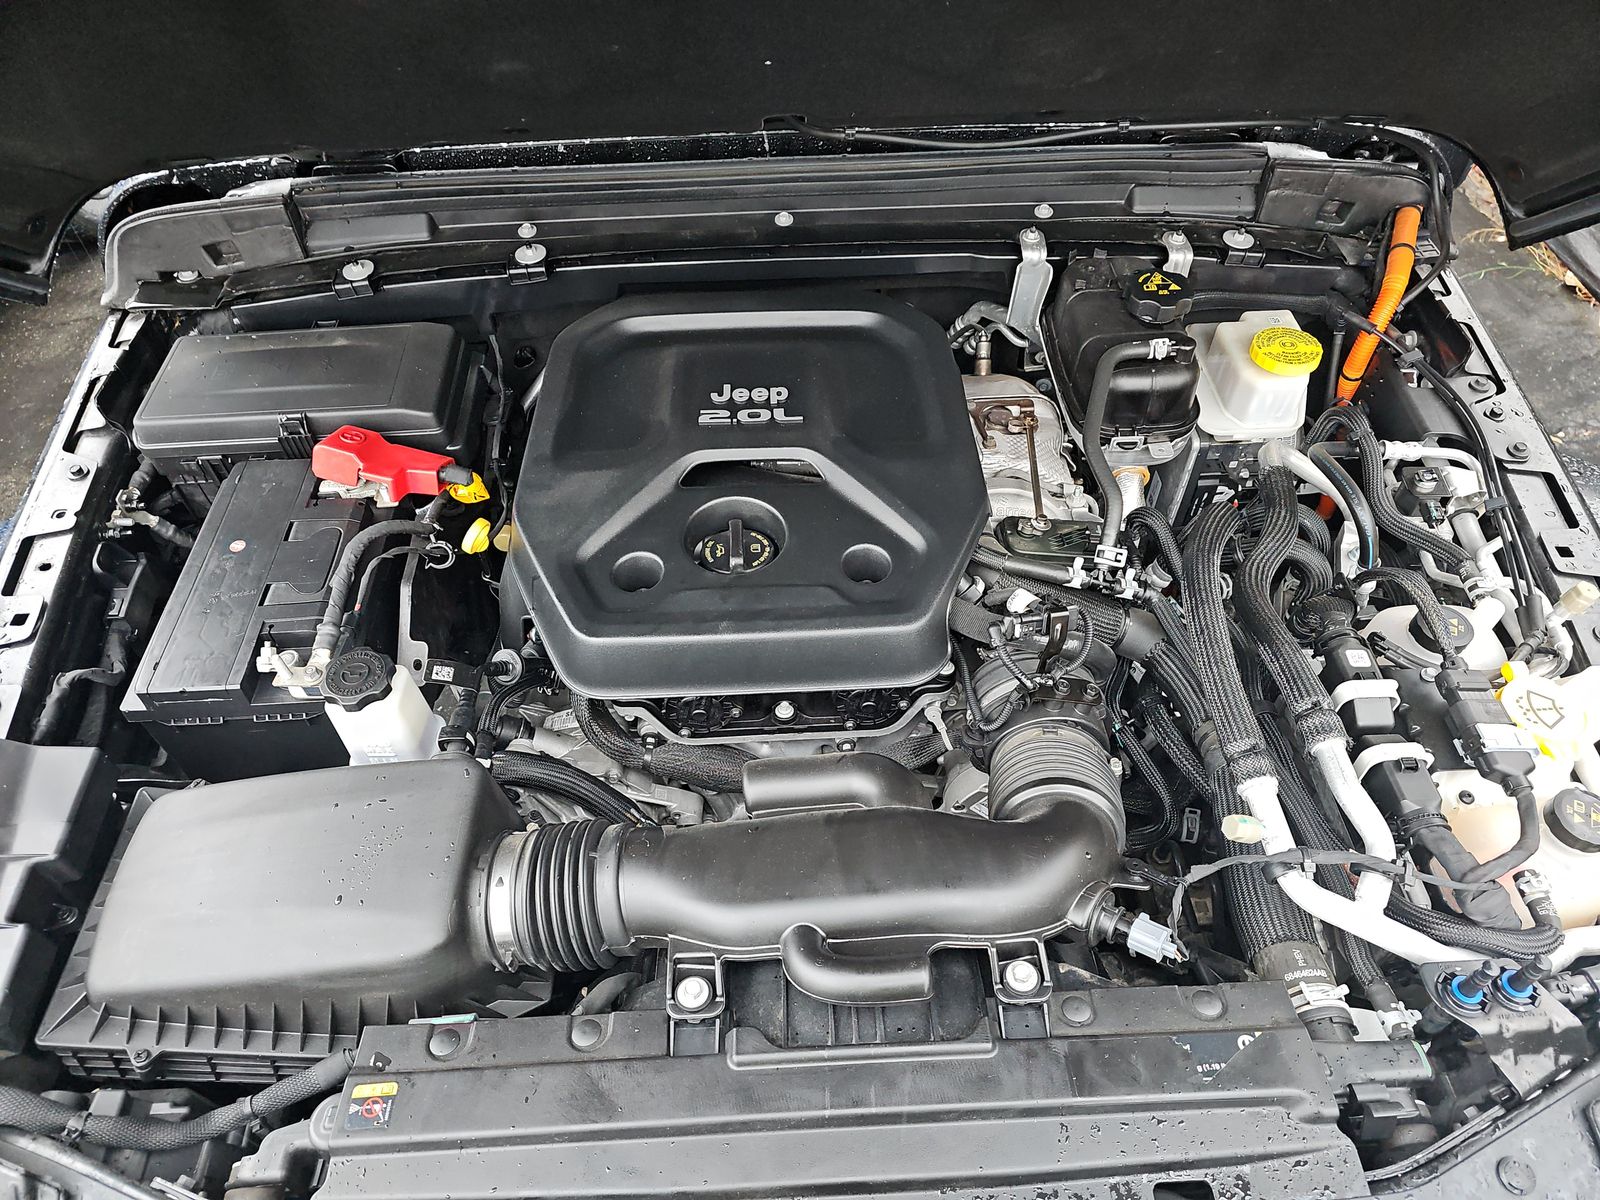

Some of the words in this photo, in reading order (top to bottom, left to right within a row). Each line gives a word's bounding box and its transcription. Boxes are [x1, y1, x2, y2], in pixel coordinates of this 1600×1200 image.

[710, 383, 789, 405] Jeep
[698, 408, 804, 425] 2.0L
[1292, 949, 1307, 967] PHEV
